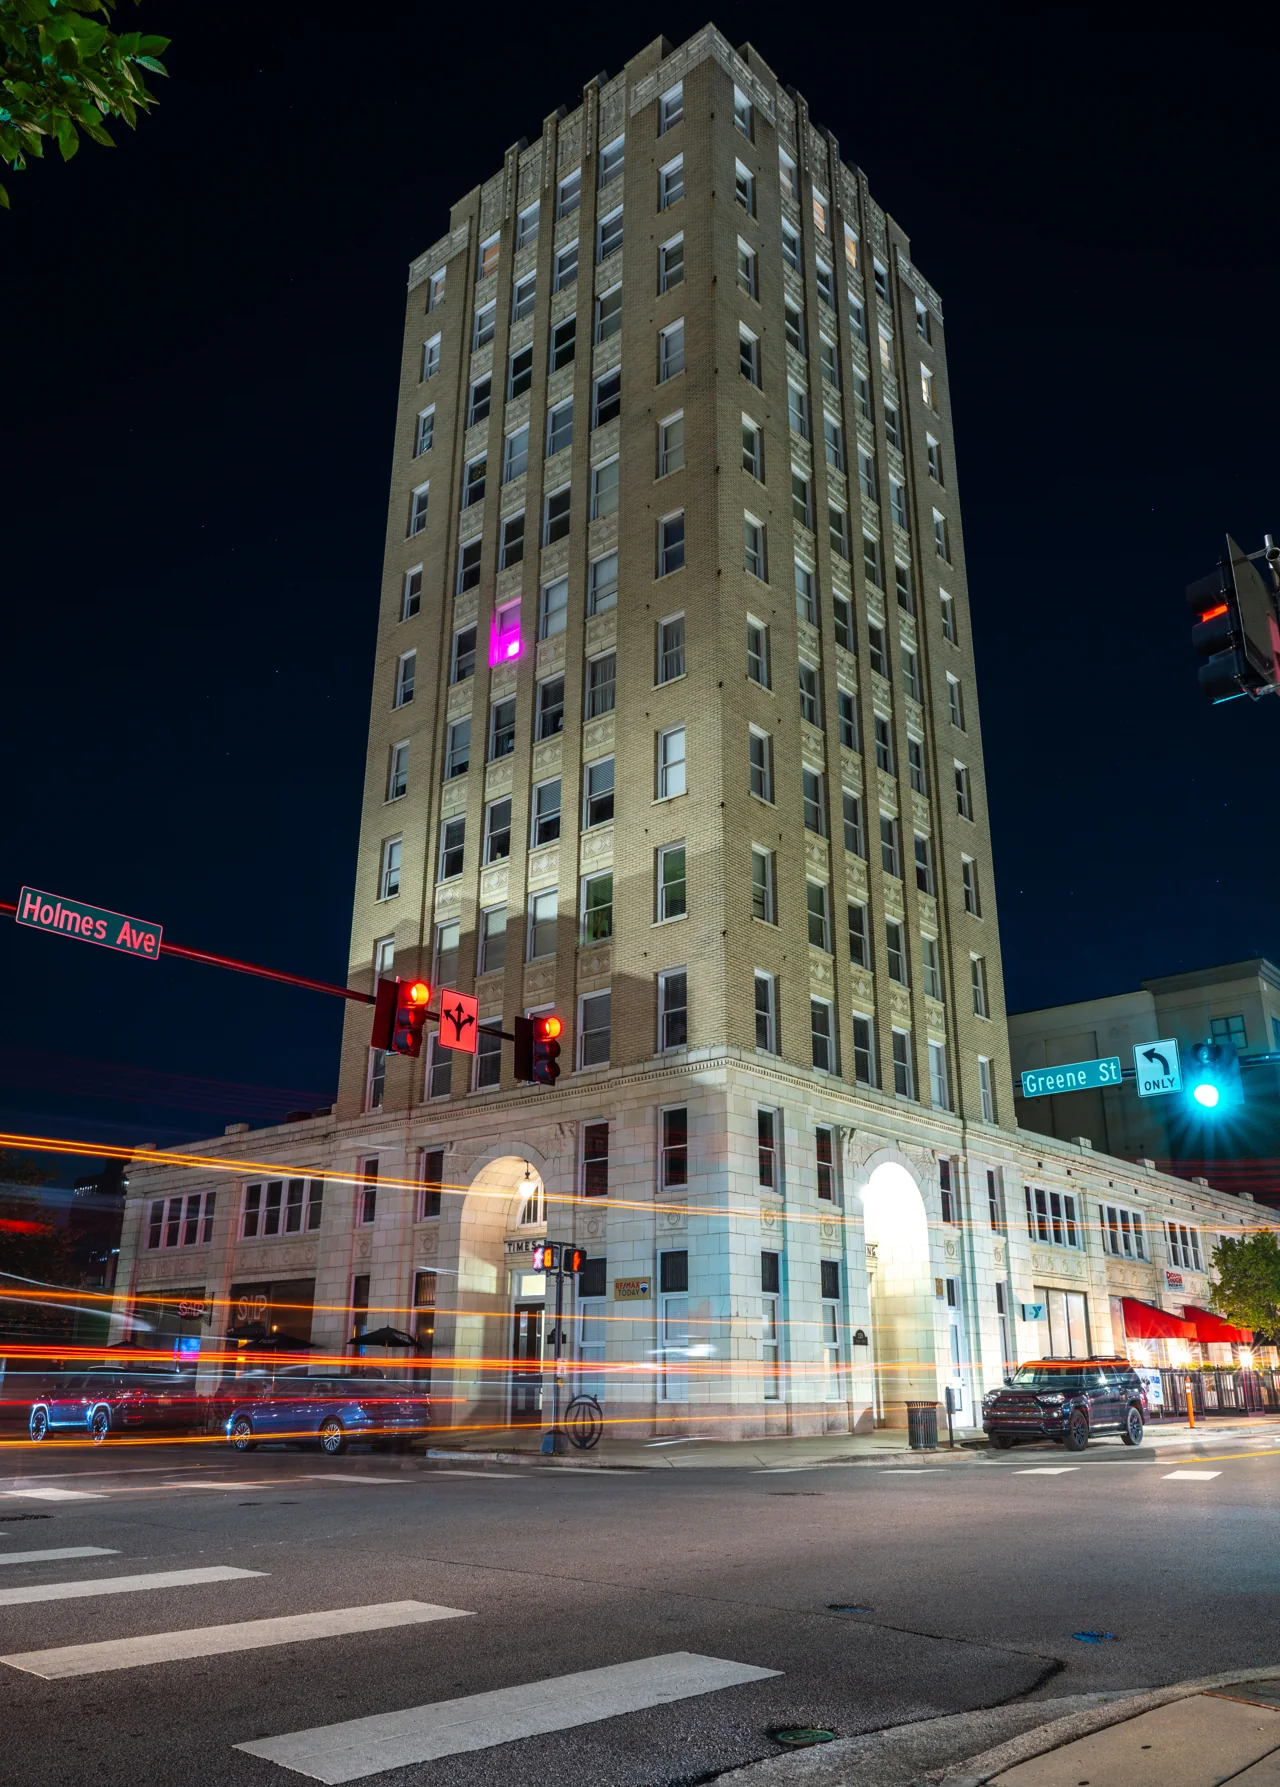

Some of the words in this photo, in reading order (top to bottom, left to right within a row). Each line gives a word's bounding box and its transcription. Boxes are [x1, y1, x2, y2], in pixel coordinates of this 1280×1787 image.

[22, 893, 108, 940] Holmes
[116, 921, 156, 953] Ave
[1026, 1070, 1087, 1093] Greene
[1099, 1062, 1117, 1082] St
[1144, 1077, 1176, 1091] ONLY
[507, 1241, 537, 1253] TIMES
[615, 1281, 640, 1290] RE/MAX
[617, 1289, 640, 1297] TODAY
[237, 1294, 267, 1321] SIP
